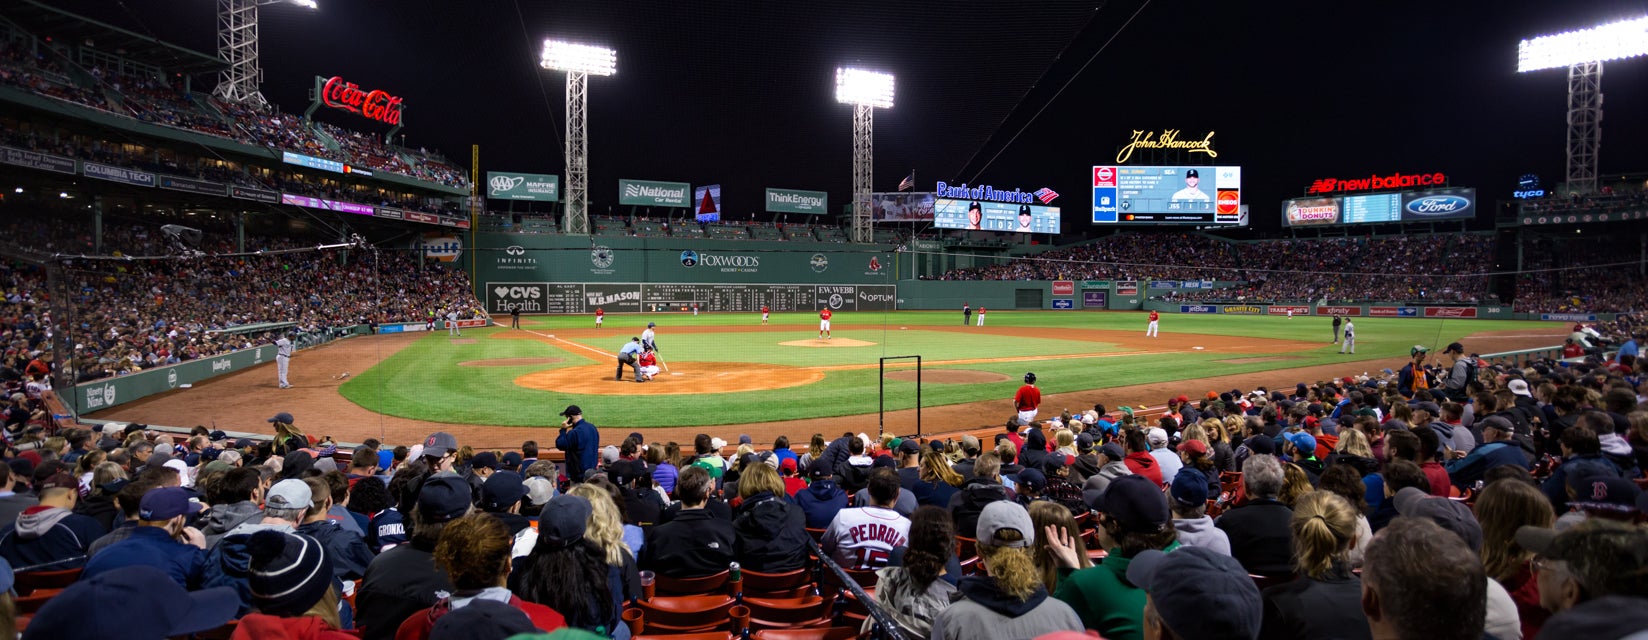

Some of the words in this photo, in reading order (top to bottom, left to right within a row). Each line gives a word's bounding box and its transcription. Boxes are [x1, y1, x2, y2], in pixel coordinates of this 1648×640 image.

[1116, 130, 1157, 164] John
[1158, 129, 1218, 158] Hancock
[86, 164, 128, 178] COLUMBIA
[130, 172, 151, 182] TECH
[494, 177, 512, 190] AAA
[1338, 178, 1370, 191] new
[1372, 172, 1445, 188] balance
[639, 186, 684, 198] National
[937, 181, 971, 199] Bank
[971, 185, 984, 200] of
[985, 186, 1033, 204] America
[1513, 190, 1544, 198] tyco
[770, 192, 821, 206] ThinkEnergy
[1418, 199, 1456, 212] Ford
[700, 254, 759, 266] FOXWOODS
[510, 286, 540, 298] CVS
[588, 292, 640, 305] W.B.MASON
[496, 300, 540, 311] Health
[1591, 482, 1608, 499] B
